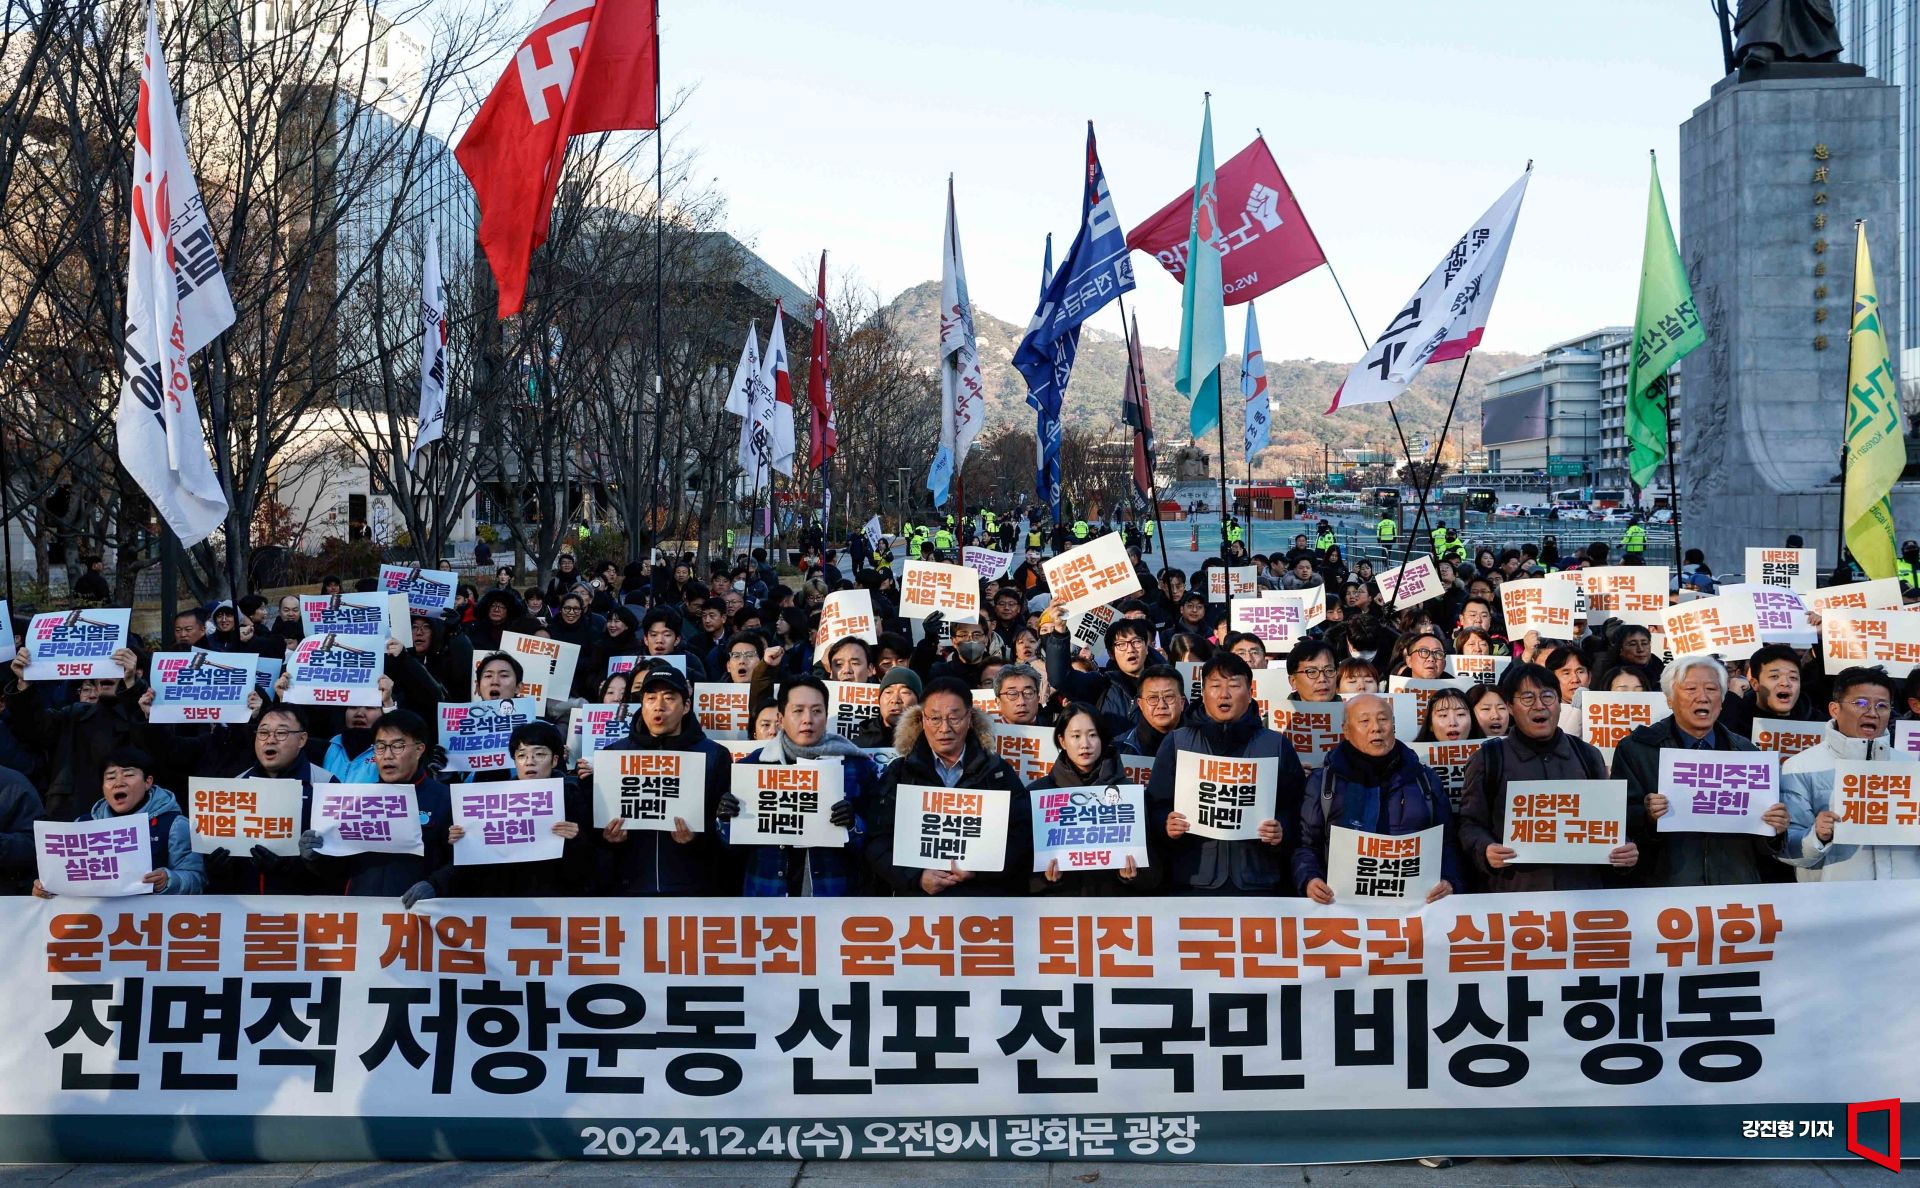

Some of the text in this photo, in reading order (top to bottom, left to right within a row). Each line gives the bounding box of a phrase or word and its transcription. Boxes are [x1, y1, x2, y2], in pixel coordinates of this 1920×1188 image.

[965, 551, 1007, 568] 국민주권
[1762, 551, 1799, 564] 내란죄
[906, 570, 952, 589] 위헌적
[1050, 553, 1096, 586] 위헌적
[1089, 561, 1131, 590] 규탄!
[1762, 563, 1799, 576] 윤석열
[304, 602, 327, 611] 내란
[905, 587, 976, 611] 계엄 규탄!
[1504, 588, 1542, 608] 위헌적
[1589, 594, 1663, 612] 계엄 규탄!
[1753, 592, 1804, 611] 민주권
[34, 617, 64, 629] 내란
[321, 606, 382, 624] 윤석열을
[1239, 606, 1300, 623] 국민주권
[1506, 607, 1569, 626] 계엄 규탄!
[1668, 607, 1721, 635] 위헌적
[51, 623, 120, 642] 윤석열을
[832, 615, 869, 637] 규탄!
[1252, 624, 1288, 641] 실현!
[38, 641, 114, 658] 탄핵하라!
[300, 641, 320, 652] 내란
[516, 637, 560, 659] 내란죄
[1673, 632, 1707, 655] 계엄
[1710, 623, 1755, 647] 규탄!
[309, 650, 376, 668] 윤석열을
[1828, 640, 1868, 660] 계엄
[57, 663, 93, 676] 진보당
[157, 659, 189, 671] 내란
[296, 667, 371, 684] 탄핵하라!
[1457, 658, 1495, 673] 내란죄
[177, 668, 247, 686] 윤석열을
[164, 685, 240, 700] 탄핵하라!
[313, 688, 350, 703] 진보당
[699, 693, 749, 712] 위헌적
[183, 707, 221, 720] 진보당
[442, 707, 468, 719] 내란
[587, 710, 613, 722] 내란
[699, 713, 731, 731] 계엄
[1273, 709, 1331, 733] 위헌적
[1589, 703, 1651, 725] 위헌적
[468, 753, 505, 768] 진보당
[620, 755, 680, 776] 내란죄
[757, 769, 818, 791] 내란죄
[1199, 759, 1257, 784] 내란죄
[1672, 761, 1770, 790] 국민주권
[621, 777, 680, 798] 윤석열
[1199, 781, 1256, 807] 윤석열
[1842, 774, 1912, 799] 위헌적
[195, 790, 257, 814] 위헌적
[322, 795, 408, 820] 국민주권
[462, 791, 554, 820] 국민주권
[621, 799, 666, 820] 파면!
[758, 791, 818, 813] 윤석열
[922, 791, 983, 816] 내란죄
[1040, 794, 1070, 809] 내란
[1512, 794, 1580, 817] 위헌적
[1692, 790, 1749, 816] 실현!
[1059, 804, 1136, 826] 윤석열을
[1198, 804, 1242, 830] 파면!
[1841, 801, 1888, 825] 계엄
[195, 814, 293, 839] 계엄 규탄!
[338, 820, 391, 841] 실현!
[483, 819, 535, 845] 실현!
[757, 813, 804, 836] 파면!
[921, 814, 982, 838] 윤석열
[1510, 819, 1619, 844] 계엄 규탄!
[44, 827, 138, 857] 국민주권
[1047, 825, 1131, 846] 체포하라!
[920, 837, 966, 861] 파면!
[1357, 836, 1421, 859] 내란죄
[65, 856, 119, 881] 실현!
[1068, 850, 1111, 867] 진보당
[1356, 857, 1420, 878] 윤석열
[1355, 878, 1405, 898] 파면!
[46, 903, 1782, 978] 윤석열 불법 계엄 규탄 내란죄 윤석열 퇴진 국민주권 실현을 위한
[45, 971, 1776, 1097] 전면적 저항운동 선포 전국민 비상 행동
[580, 1115, 1201, 1160] 2024.12.4(수) 오전9시 광화문 광장
